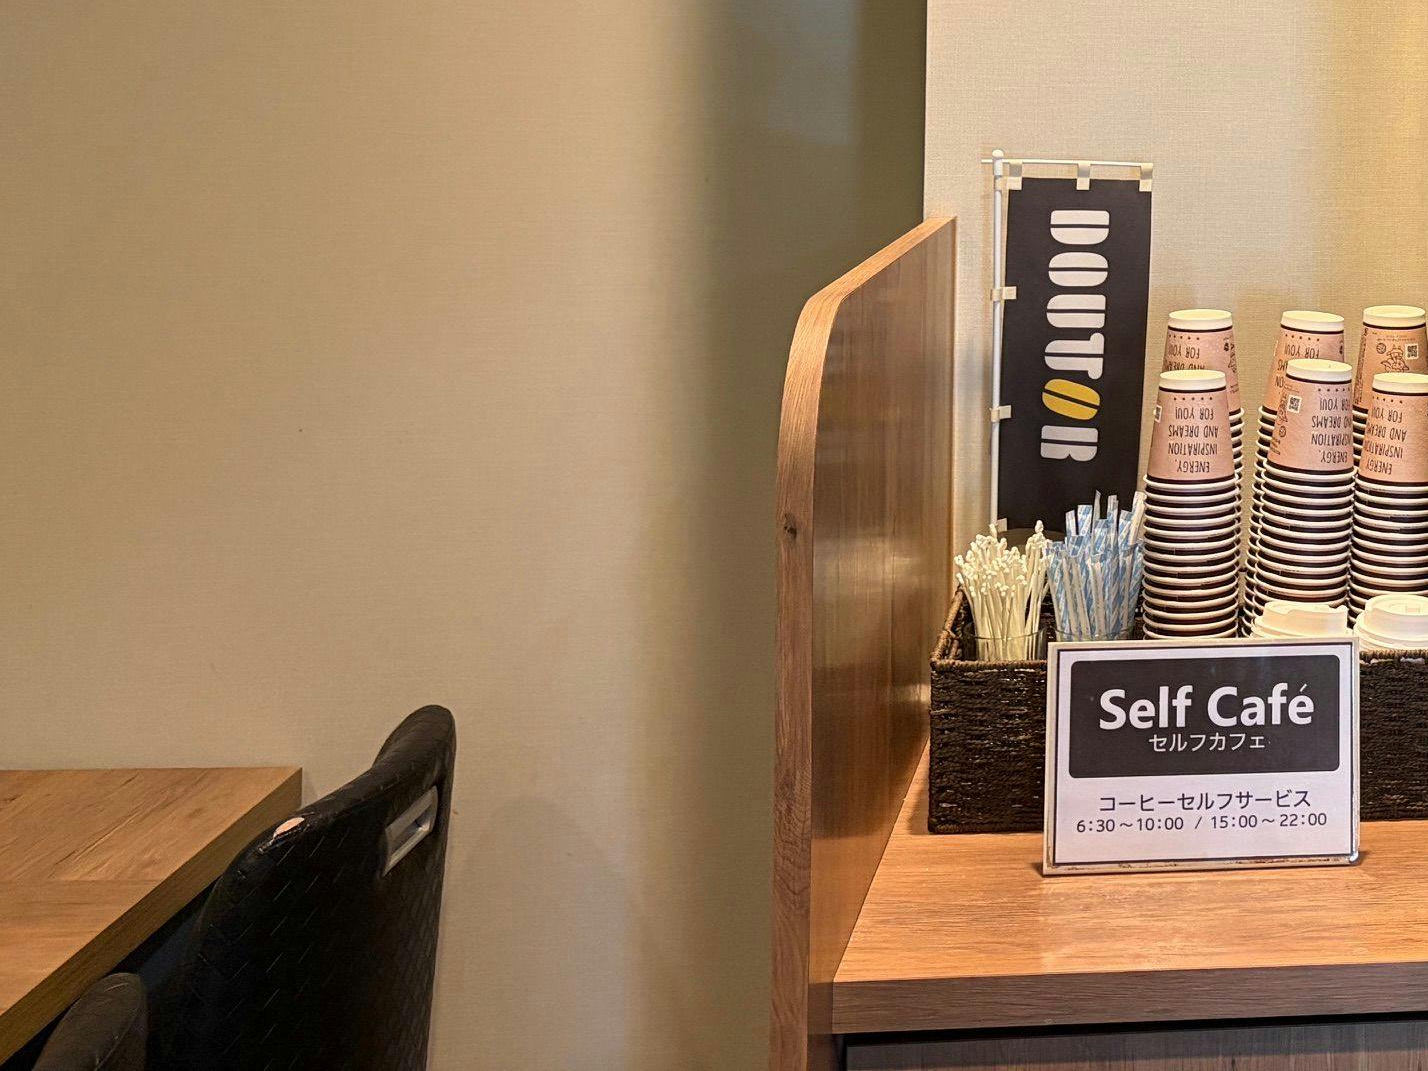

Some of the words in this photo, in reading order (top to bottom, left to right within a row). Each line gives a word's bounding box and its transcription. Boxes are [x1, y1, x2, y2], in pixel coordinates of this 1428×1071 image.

[1040, 209, 1110, 462] DOUTOR
[1175, 407, 1196, 420] YOU!
[1199, 407, 1214, 420] FOR
[1387, 410, 1403, 423] FOR
[1311, 415, 1341, 428] DREAMS
[1168, 425, 1199, 437] DREAMS
[1203, 426, 1219, 438] AND
[1389, 429, 1407, 443] AND
[1168, 443, 1218, 455] INSPIRATION
[1099, 685, 1193, 731] Self
[1207, 682, 1315, 728] Café
[1149, 732, 1266, 753] セルフカフェ
[1099, 789, 1311, 813] コーヒーセルフサービス
